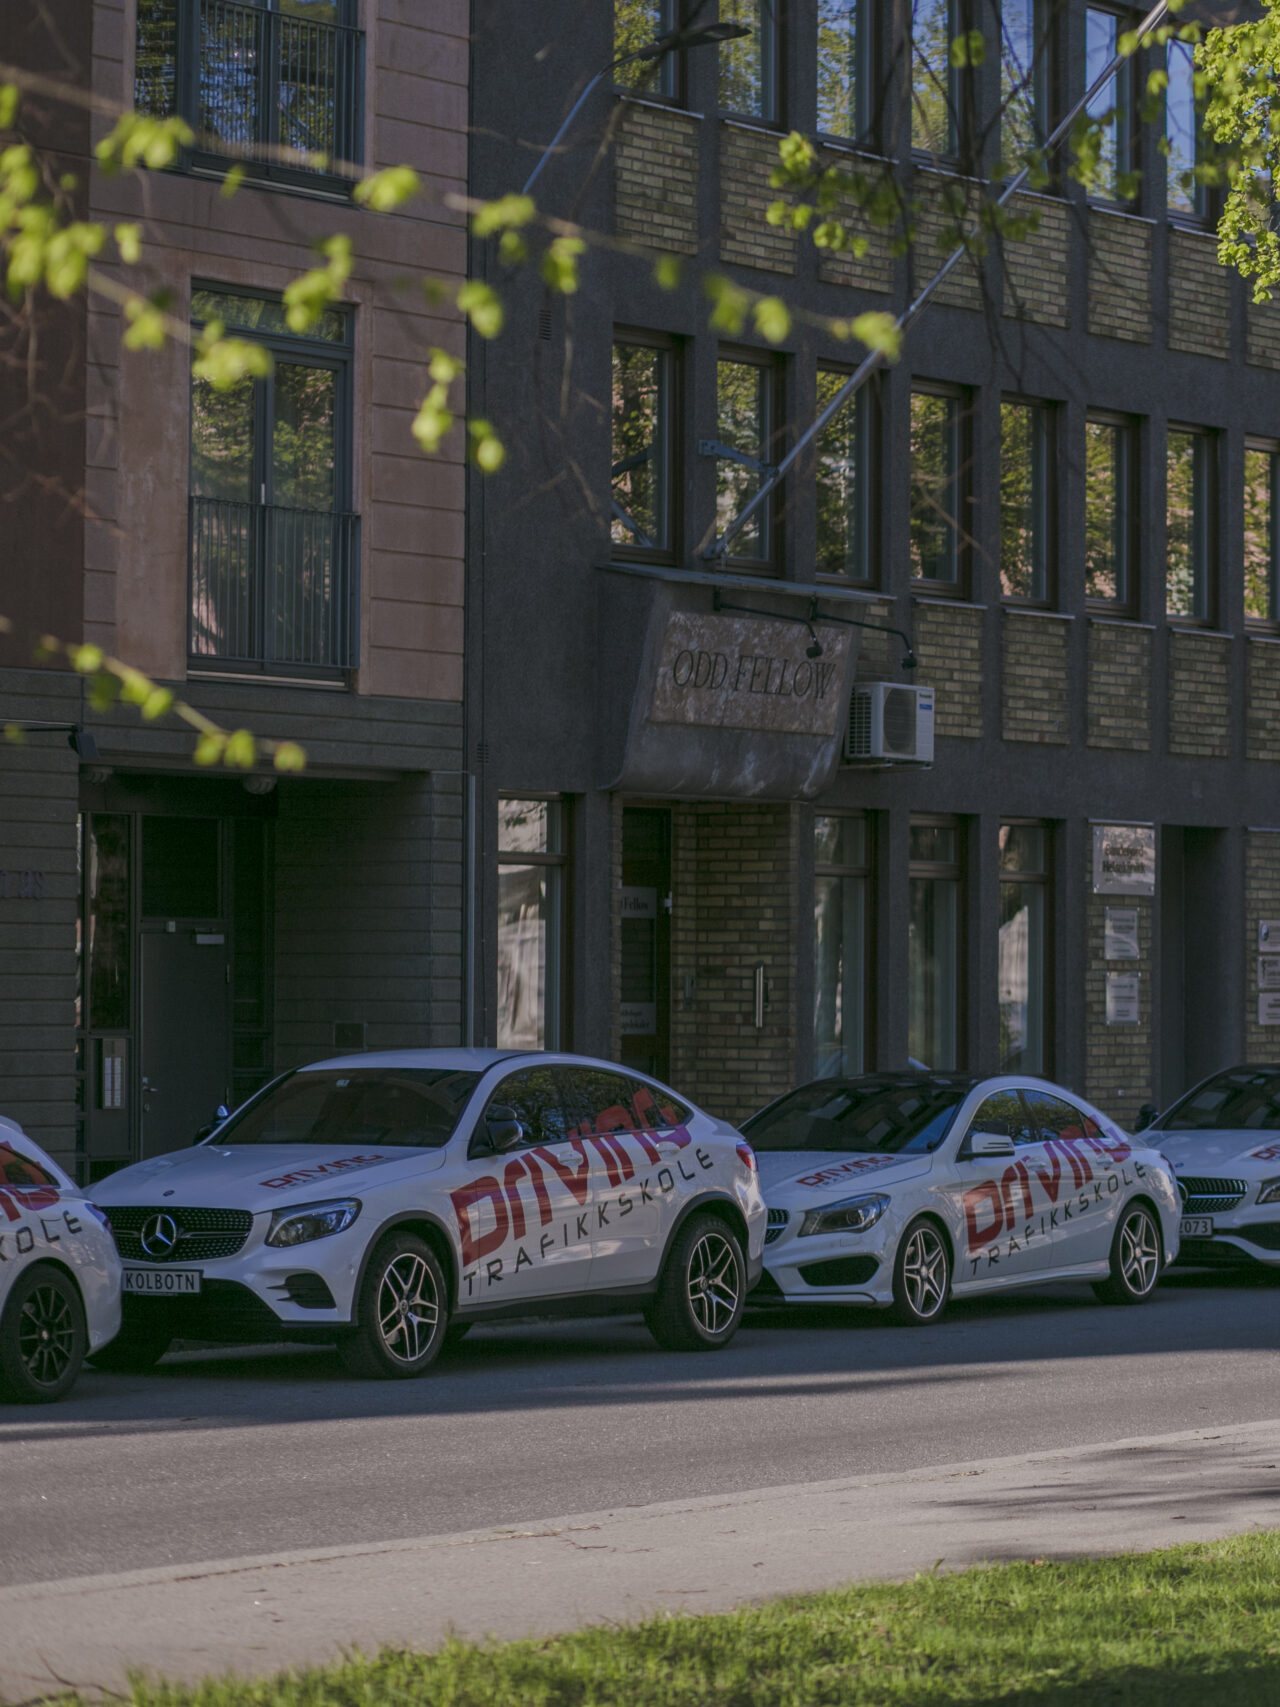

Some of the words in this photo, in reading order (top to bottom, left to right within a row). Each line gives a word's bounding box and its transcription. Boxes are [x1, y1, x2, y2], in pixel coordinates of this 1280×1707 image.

[673, 649, 727, 689] ODD
[733, 655, 837, 699] FELLOW
[463, 1148, 714, 1297] TRAFIKKSKOLE
[970, 1160, 1147, 1276] TRAFIKKSKOLE
[125, 1272, 195, 1291] KOLBOTN
